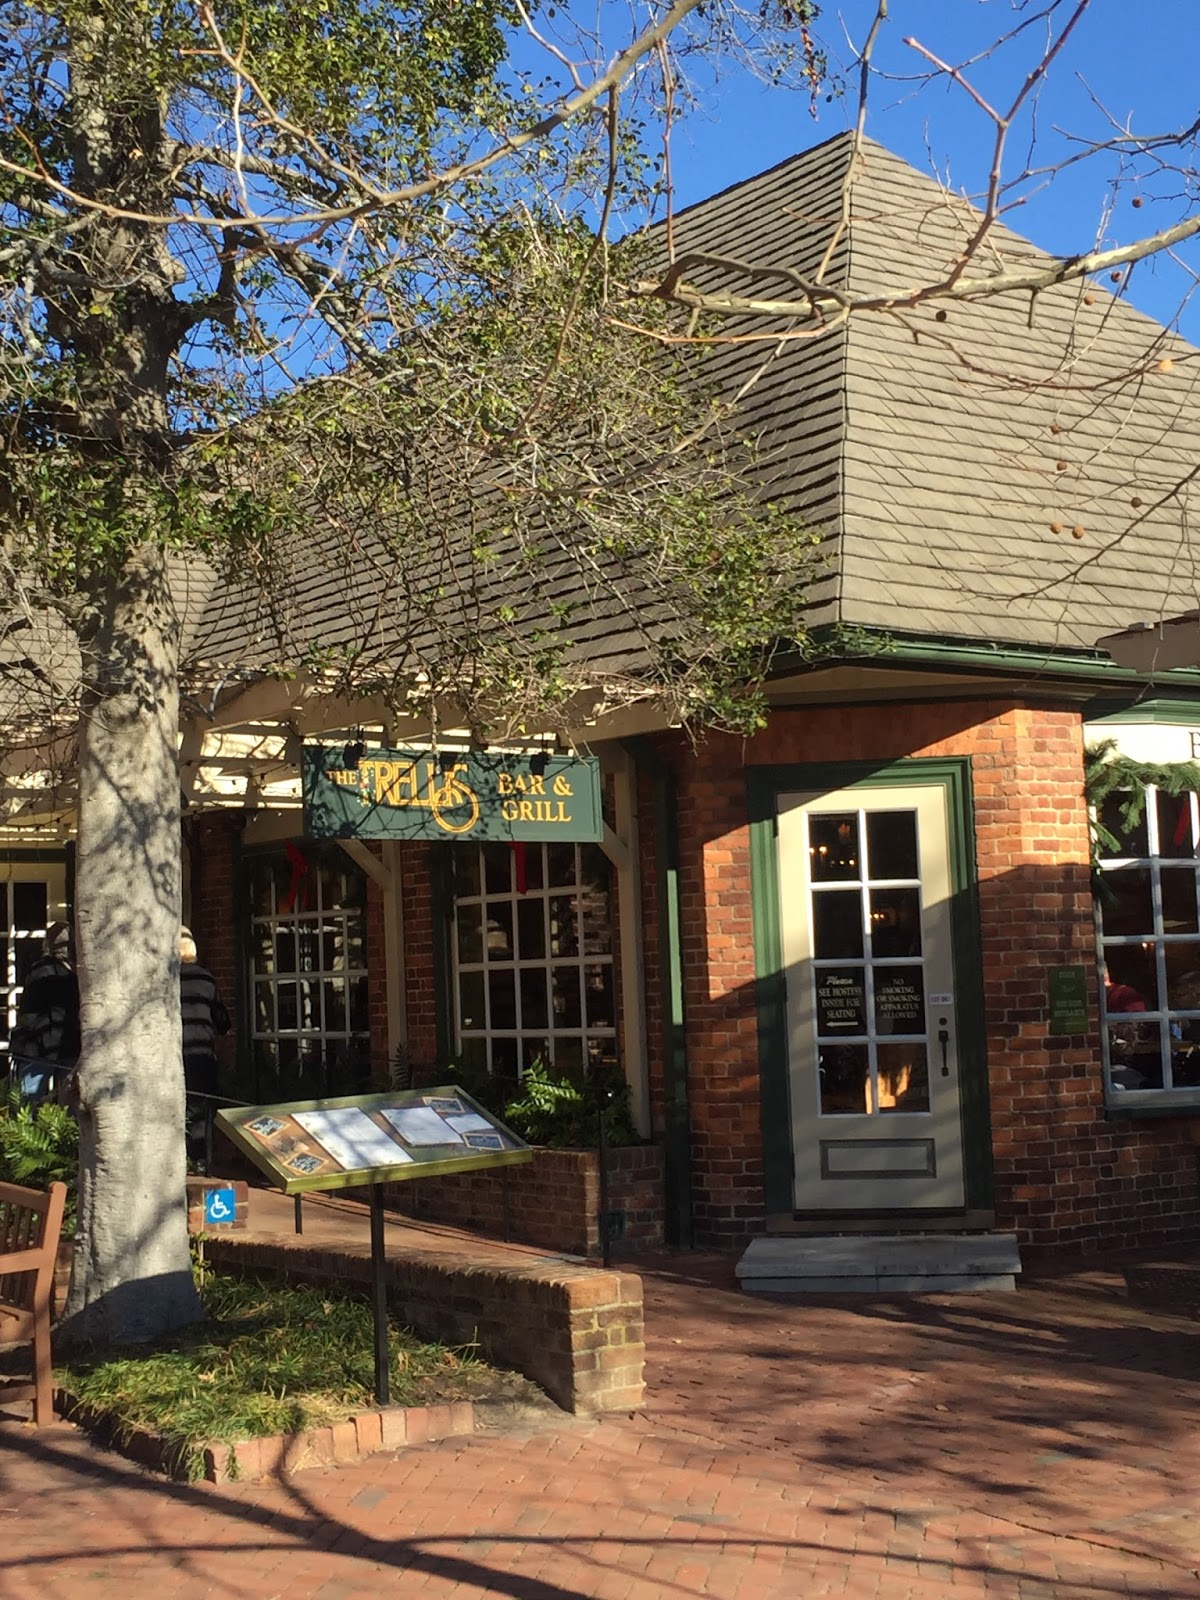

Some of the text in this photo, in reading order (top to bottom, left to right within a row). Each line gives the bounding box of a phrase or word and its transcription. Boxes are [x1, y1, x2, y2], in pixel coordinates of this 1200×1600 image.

[326, 769, 357, 786] THE
[497, 772, 574, 796] BAR &
[501, 800, 572, 823] GRILL
[826, 975, 854, 985] Please
[893, 978, 904, 986] NO
[818, 986, 862, 997] SEE HOSTESS
[881, 986, 915, 994] SMOKING
[821, 998, 860, 1008] INSIDE FOR
[876, 994, 921, 1003] OR SMOKING
[880, 1003, 919, 1011] APPARATUS
[827, 1009, 856, 1018] SEATING
[882, 1011, 917, 1019] ALLOWED
